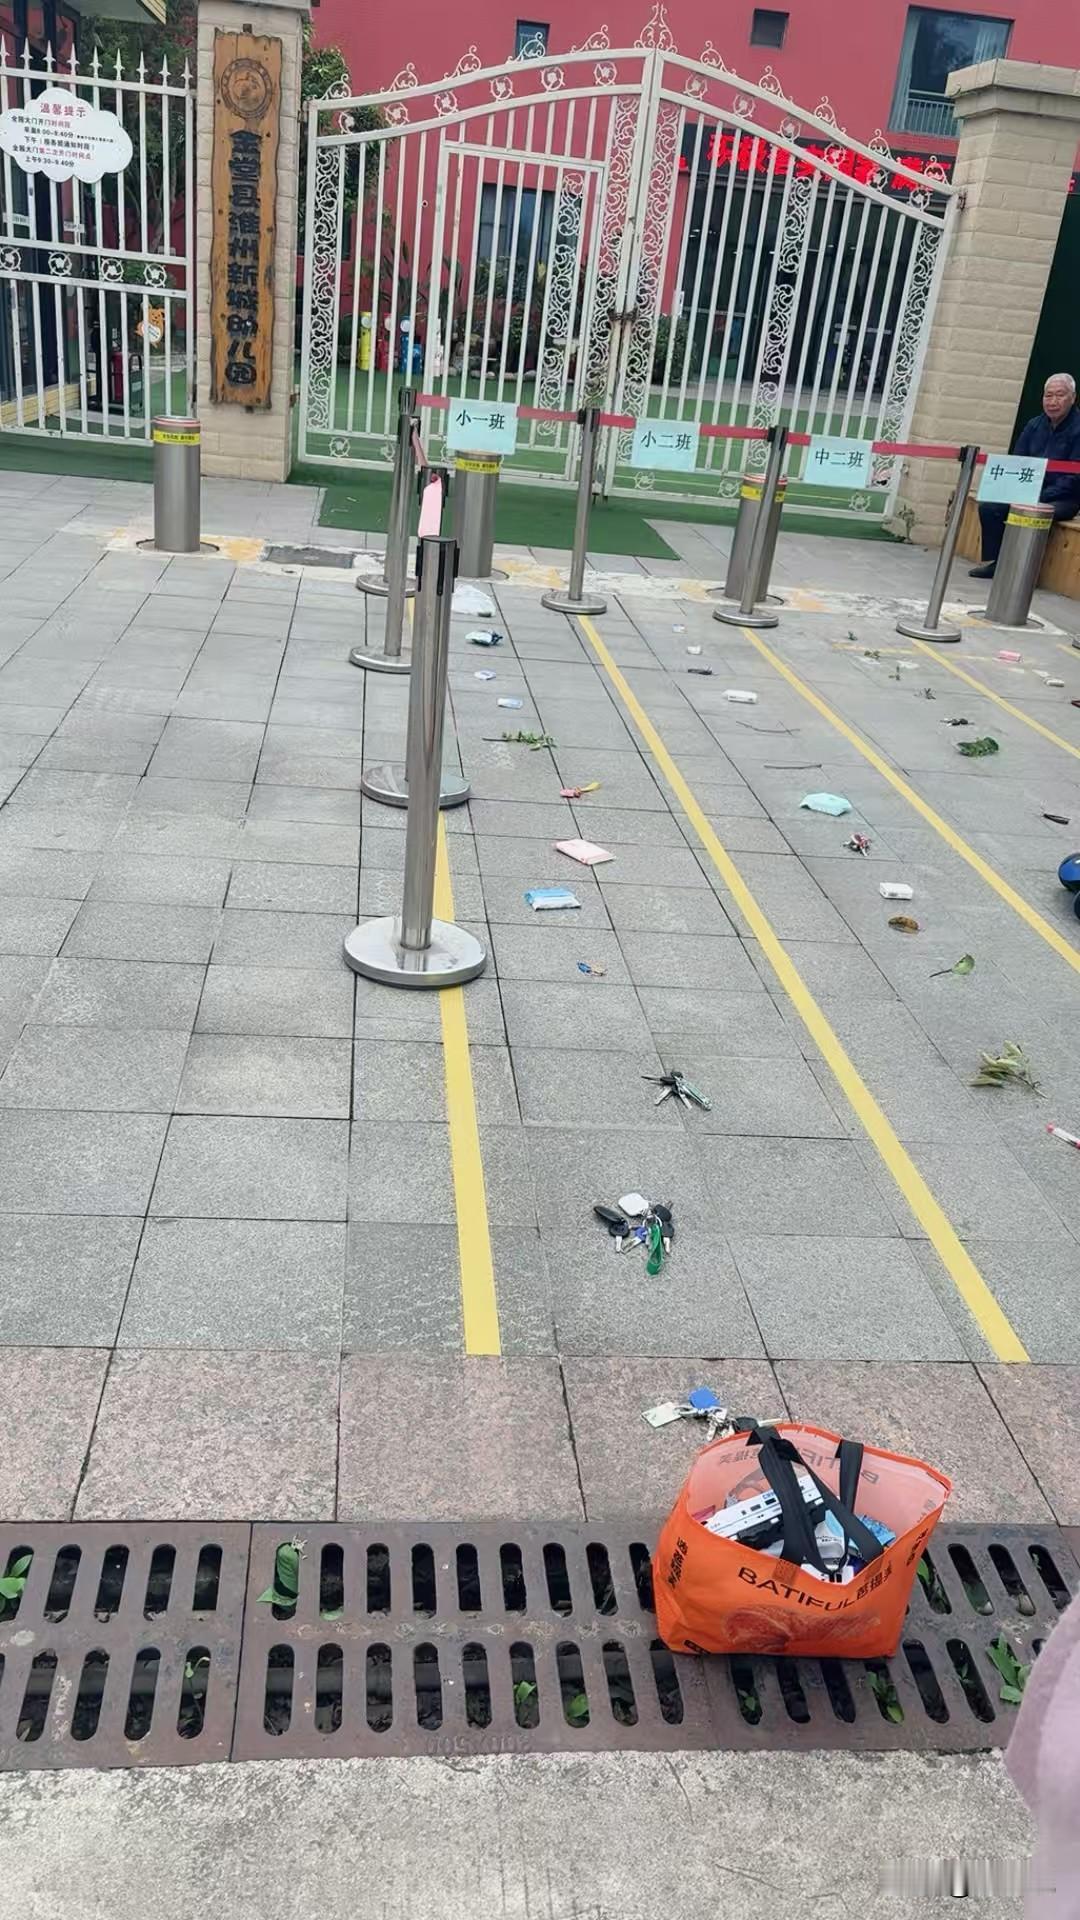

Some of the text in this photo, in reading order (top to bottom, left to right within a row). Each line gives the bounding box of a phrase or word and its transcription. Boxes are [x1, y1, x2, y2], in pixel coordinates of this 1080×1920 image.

[40, 102, 87, 118] 温馨提示
[455, 408, 505, 431] 小一班
[640, 430, 693, 451] 小二班
[814, 447, 865, 468] 中二班
[990, 467, 1034, 484] 中一班
[738, 1566, 855, 1612] BATIFUL
